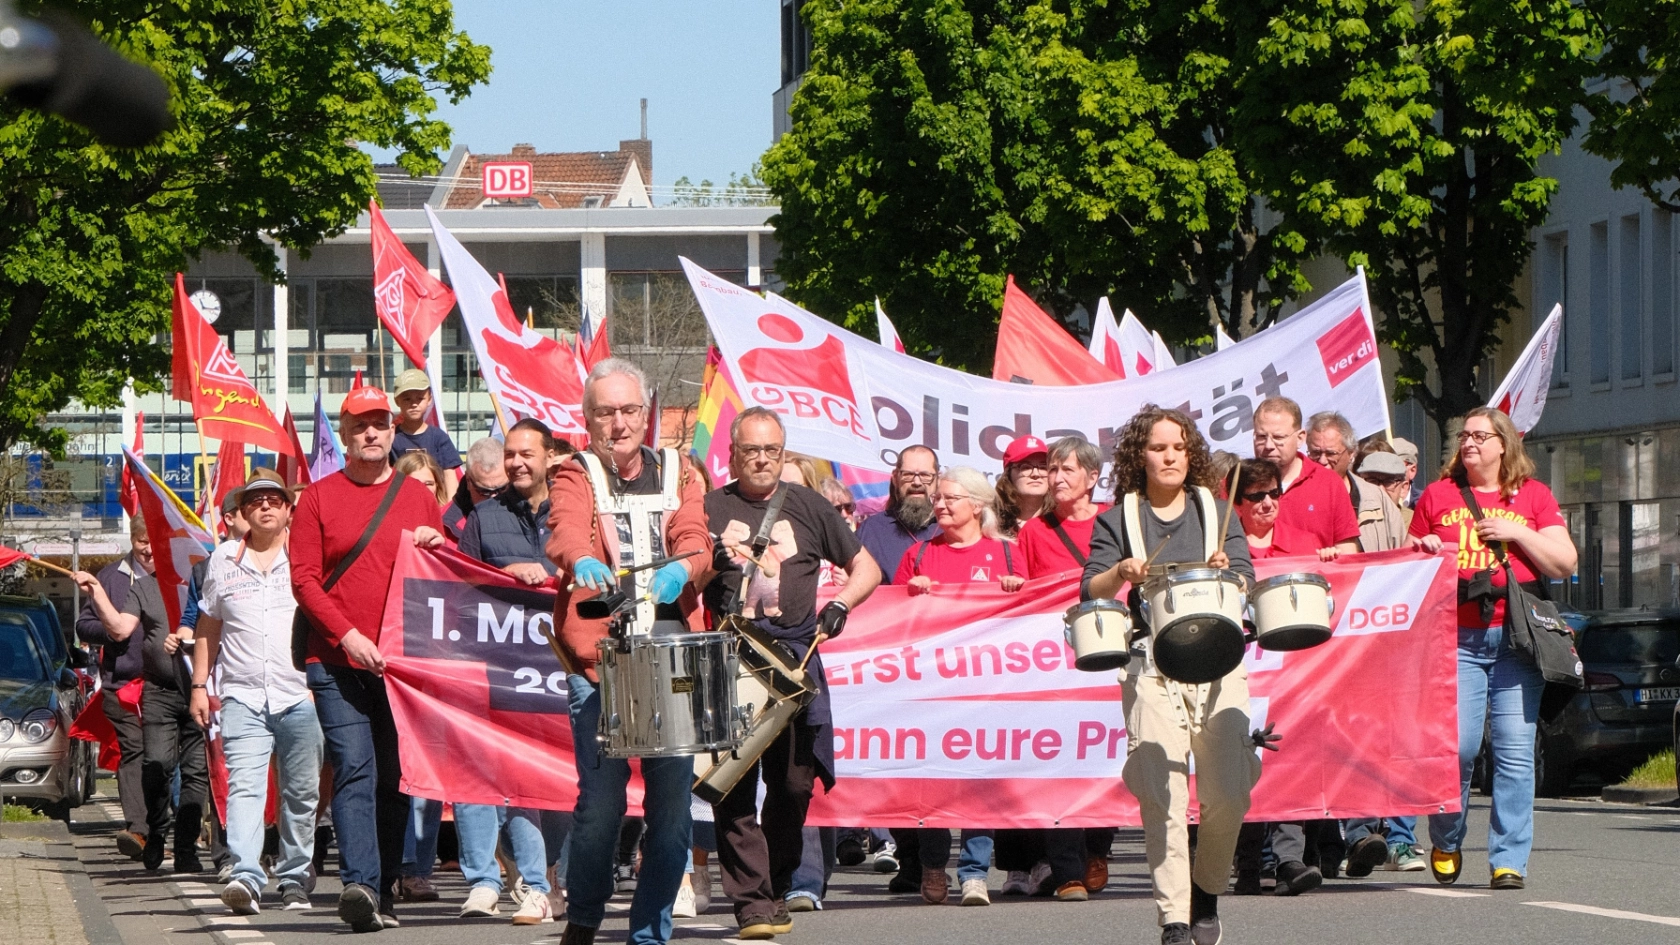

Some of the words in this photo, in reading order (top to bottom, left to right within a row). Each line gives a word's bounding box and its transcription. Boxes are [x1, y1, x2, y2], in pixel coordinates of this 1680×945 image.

[490, 168, 526, 191] DB
[1329, 339, 1373, 374] ver.di
[427, 597, 461, 641] 1.
[1349, 603, 1409, 630] DGB
[825, 645, 922, 687] Erst
[833, 727, 926, 760] ann
[941, 727, 1062, 760] eure
